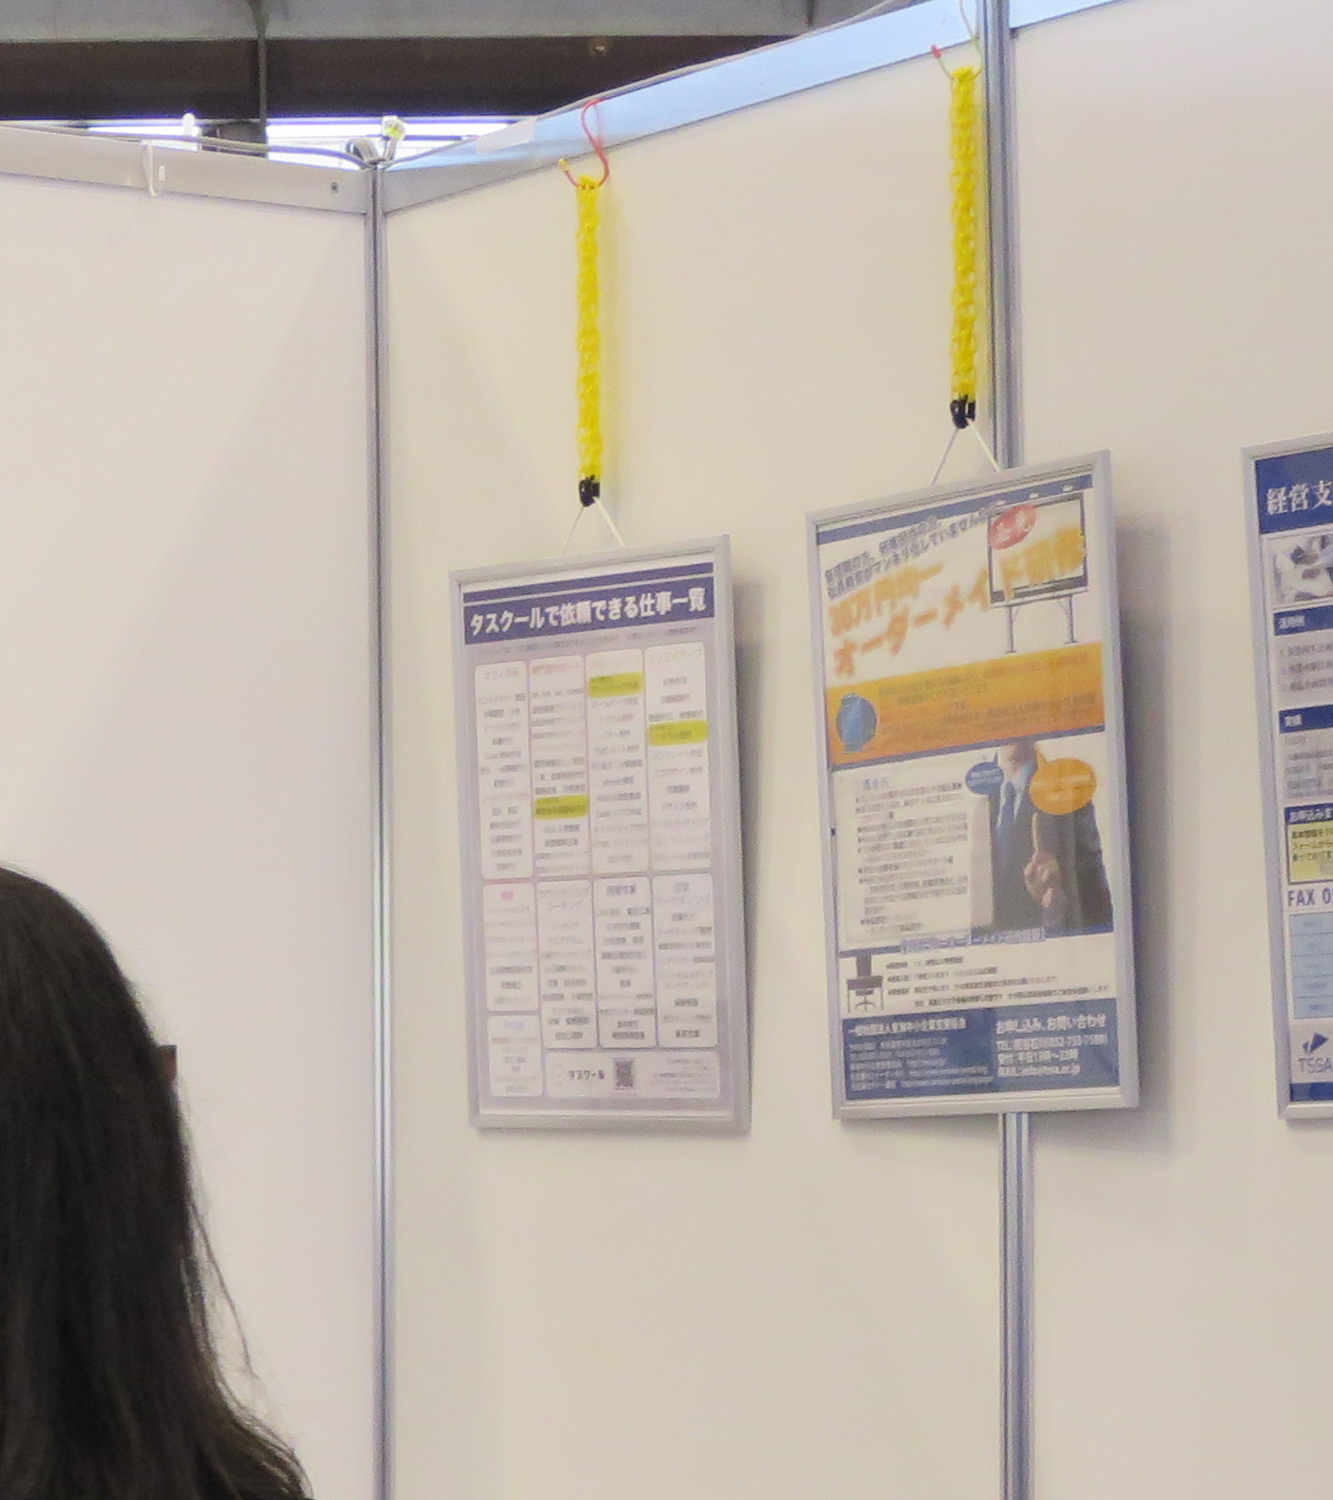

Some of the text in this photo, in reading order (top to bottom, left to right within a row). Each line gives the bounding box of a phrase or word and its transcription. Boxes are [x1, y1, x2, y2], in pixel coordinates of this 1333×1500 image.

[1266, 479, 1333, 516] 経営支
[470, 586, 707, 636] タスクールで依頼できる仕事一覧
[1288, 888, 1333, 907] FAX 0
